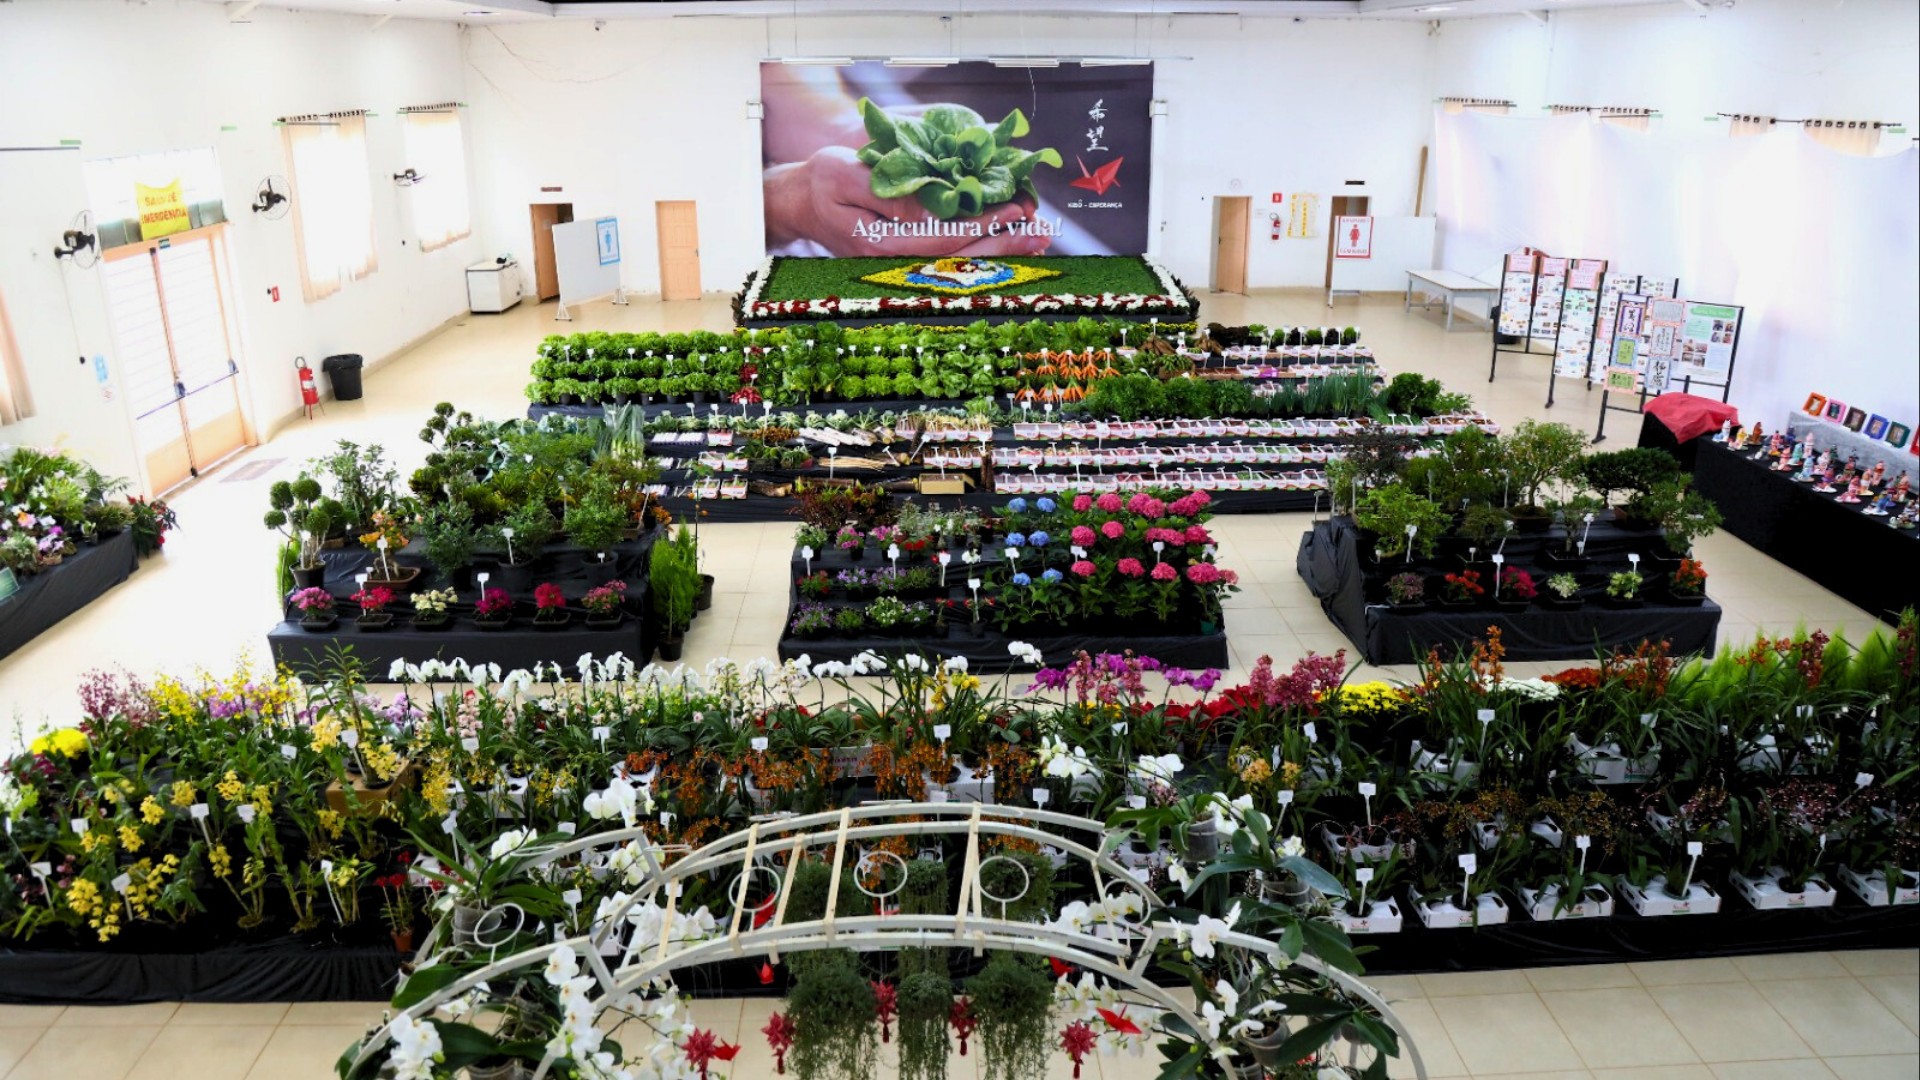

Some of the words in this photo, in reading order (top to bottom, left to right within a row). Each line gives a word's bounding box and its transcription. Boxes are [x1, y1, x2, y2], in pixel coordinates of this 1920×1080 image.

[1085, 98, 1109, 152] 希望
[851, 216, 983, 243] Agricultura
[988, 215, 1001, 237] é
[1007, 216, 1063, 237] vida!
